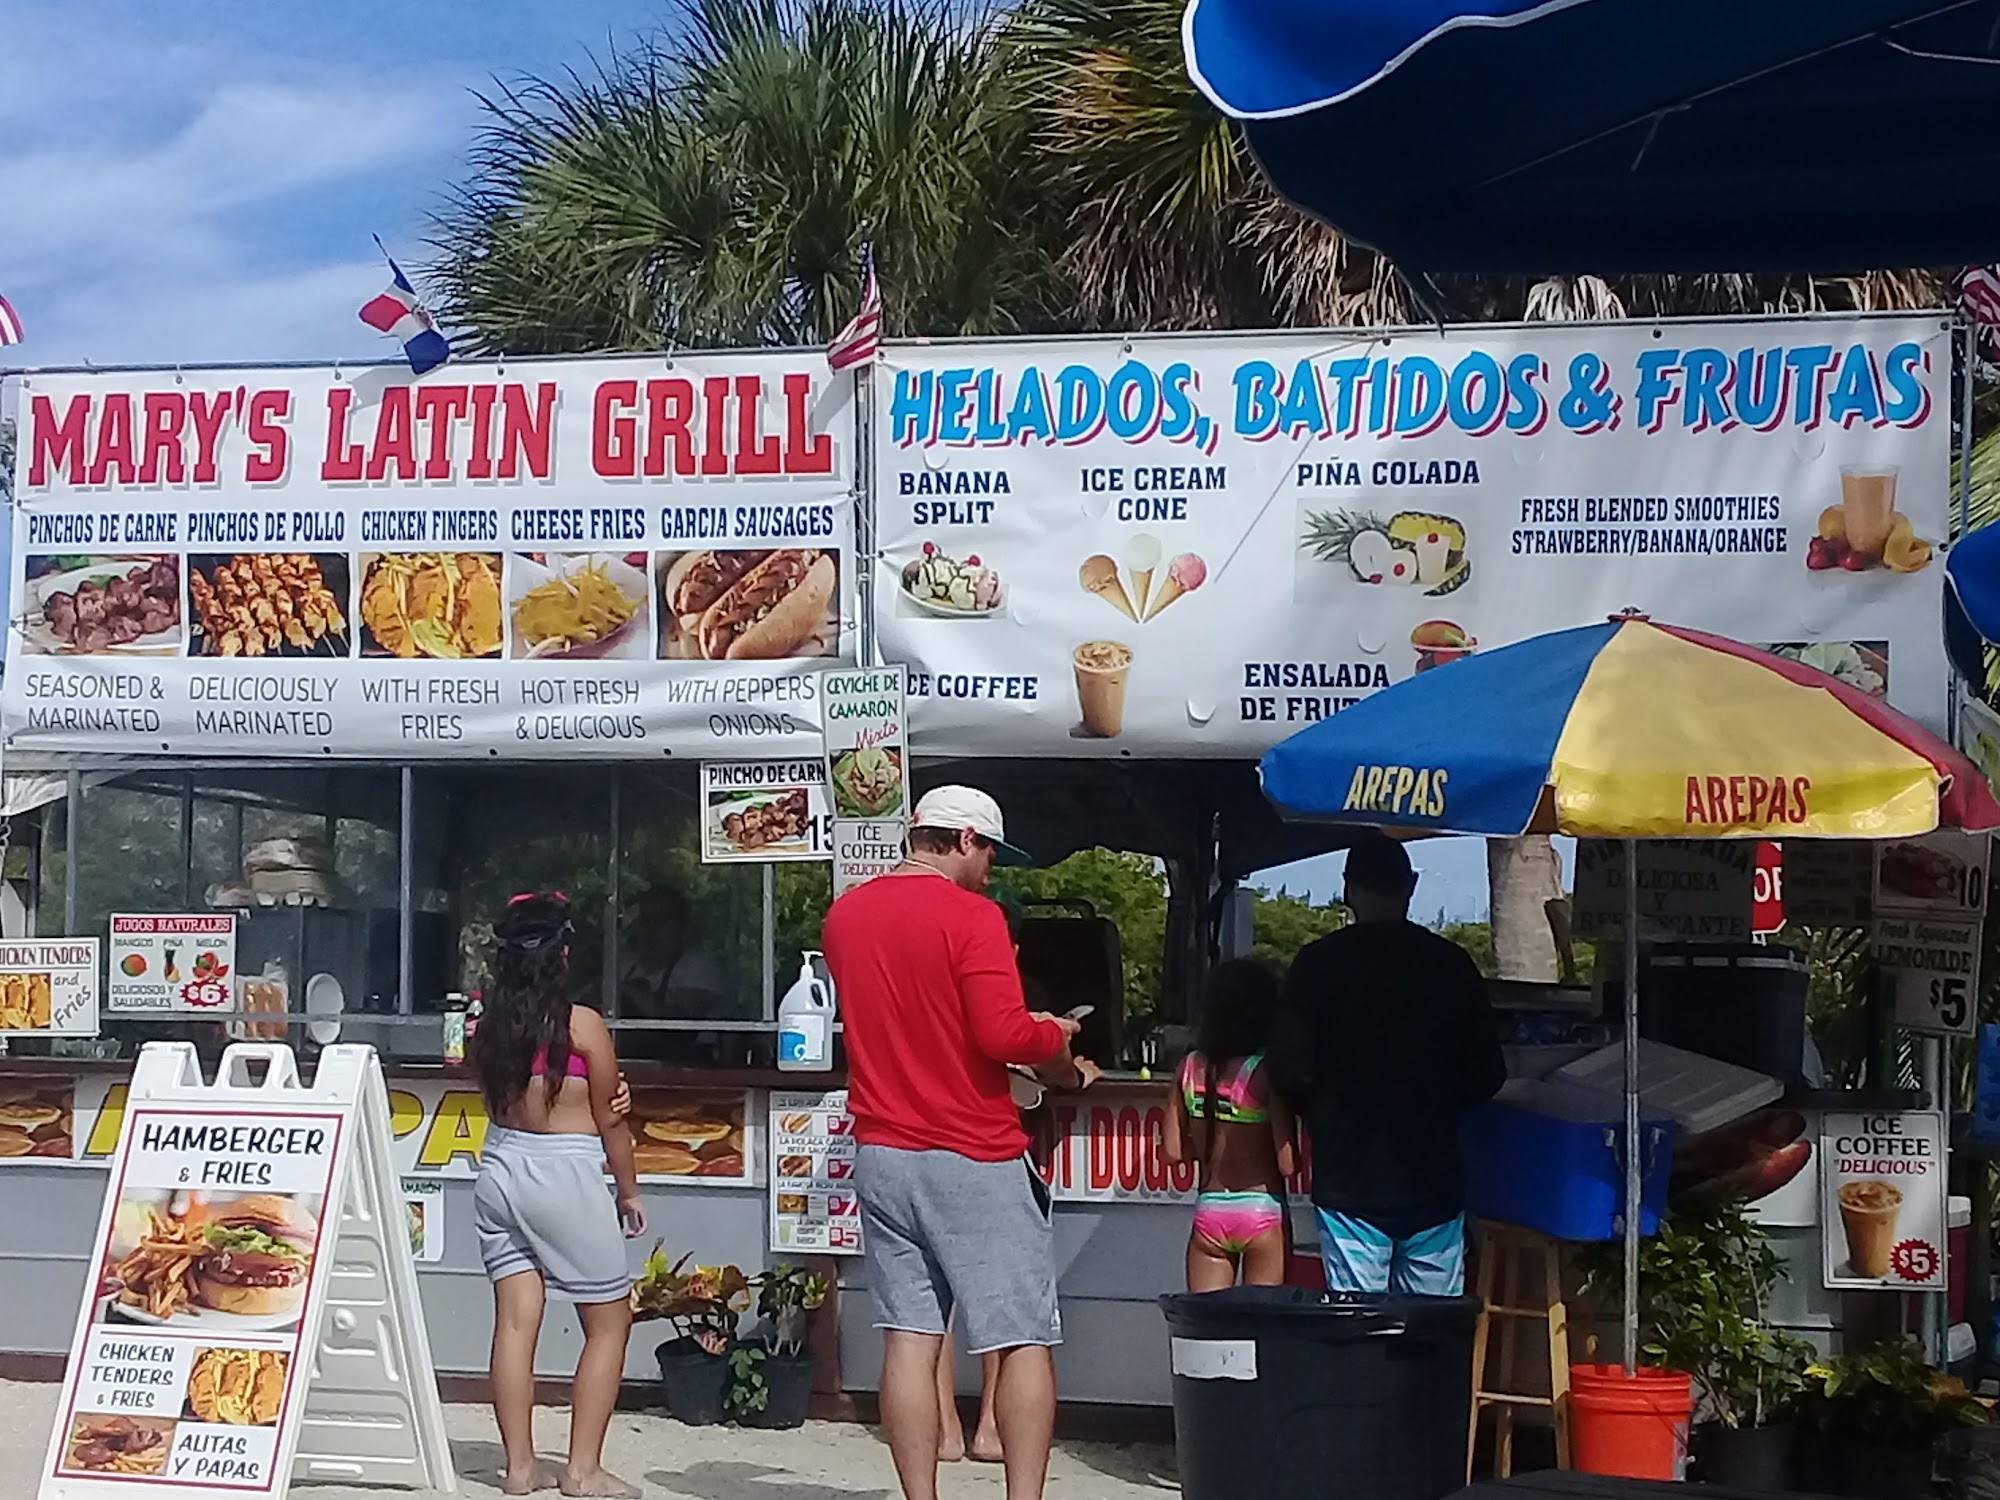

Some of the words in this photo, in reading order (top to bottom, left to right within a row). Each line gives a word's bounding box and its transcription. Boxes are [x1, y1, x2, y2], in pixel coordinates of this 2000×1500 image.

[890, 360, 1218, 454] HELADOS,
[1232, 350, 1548, 438] BATIDOS
[1558, 351, 1621, 433] &
[1635, 342, 1931, 434] FRUTAS
[28, 386, 293, 490] MARY'S
[321, 380, 560, 484] LATIN
[591, 373, 838, 482] GRILL
[899, 471, 1011, 496] BANANA
[1081, 468, 1122, 492] ICE
[1128, 466, 1227, 491] CREAM
[1297, 457, 1361, 487] PIÑA
[1371, 461, 1480, 486] COLADA
[661, 507, 728, 538] GARCIA
[733, 505, 834, 537] SAUSAGES
[913, 501, 995, 525] SPLIT
[1117, 496, 1187, 521] CONE
[1521, 498, 1578, 523] FRESH
[1585, 497, 1668, 523] BLENDED
[1674, 496, 1780, 522] SMOOTHIES
[29, 514, 94, 544] PINCHOS
[100, 514, 120, 544] DE
[125, 512, 177, 542] CARNE
[187, 512, 258, 543] PINCHOS
[264, 512, 288, 542] DE
[292, 511, 345, 541] POLLO
[361, 510, 427, 541] CHICKEN
[432, 509, 498, 541] FINGERS
[511, 508, 584, 540] CHEESE
[590, 508, 646, 540] FRIES
[1511, 527, 1788, 557] STRAWBERRY/BANANA/ORANGE
[26, 673, 143, 701] SEASONED
[149, 675, 165, 700] &
[826, 675, 879, 695] CEVICHE
[883, 674, 899, 691] DE
[906, 674, 930, 696] CE
[936, 674, 1039, 700] COFFEE
[1244, 663, 1390, 688] ENSALADA
[189, 676, 338, 702] DELICIOUSLY
[362, 678, 420, 703] WITH
[427, 679, 500, 704] FRESH
[521, 679, 569, 704] HOT
[574, 678, 640, 704] FRESH
[667, 678, 720, 704] WITH
[723, 674, 816, 702] PEPPERS
[28, 707, 160, 733] MARINATED
[1240, 697, 1276, 721] DE
[195, 710, 333, 737] MARINATED
[401, 714, 463, 740] FRIES
[515, 719, 528, 740] &
[535, 714, 647, 740] DELICIOUS
[709, 713, 796, 737] ONIONS
[856, 719, 899, 749] Mixto
[710, 765, 764, 785] PINCHO
[767, 765, 786, 783] DE
[789, 763, 827, 782] CARN
[1343, 764, 1450, 818] AREPAS
[1684, 776, 1812, 825] AREPAS
[857, 826, 882, 841] ICE
[841, 843, 898, 860] COFFEE
[115, 918, 154, 932] JUGOS
[158, 918, 231, 932] NATURALES
[39, 946, 92, 965] TENDERS
[1878, 944, 1973, 974] LEMONADE
[54, 971, 80, 986] and
[187, 983, 222, 1004] $6
[1929, 978, 1967, 1028] $5
[53, 985, 92, 1029] Fries
[1862, 1116, 1903, 1136] ICE
[142, 1123, 325, 1156] HAMBERGER
[1835, 1137, 1932, 1157] COFFEE
[178, 1166, 191, 1184] &
[201, 1160, 272, 1186] FRIES
[1833, 1158, 1935, 1175] "DELICIOUS"
[1898, 1248, 1931, 1274] $5
[99, 1342, 175, 1363] CHICKEN
[91, 1366, 173, 1386] TENDERS
[110, 1390, 155, 1409] FRIES
[178, 1434, 248, 1455] ALITAS
[174, 1457, 189, 1475] Y
[195, 1457, 260, 1480] PAPAS
